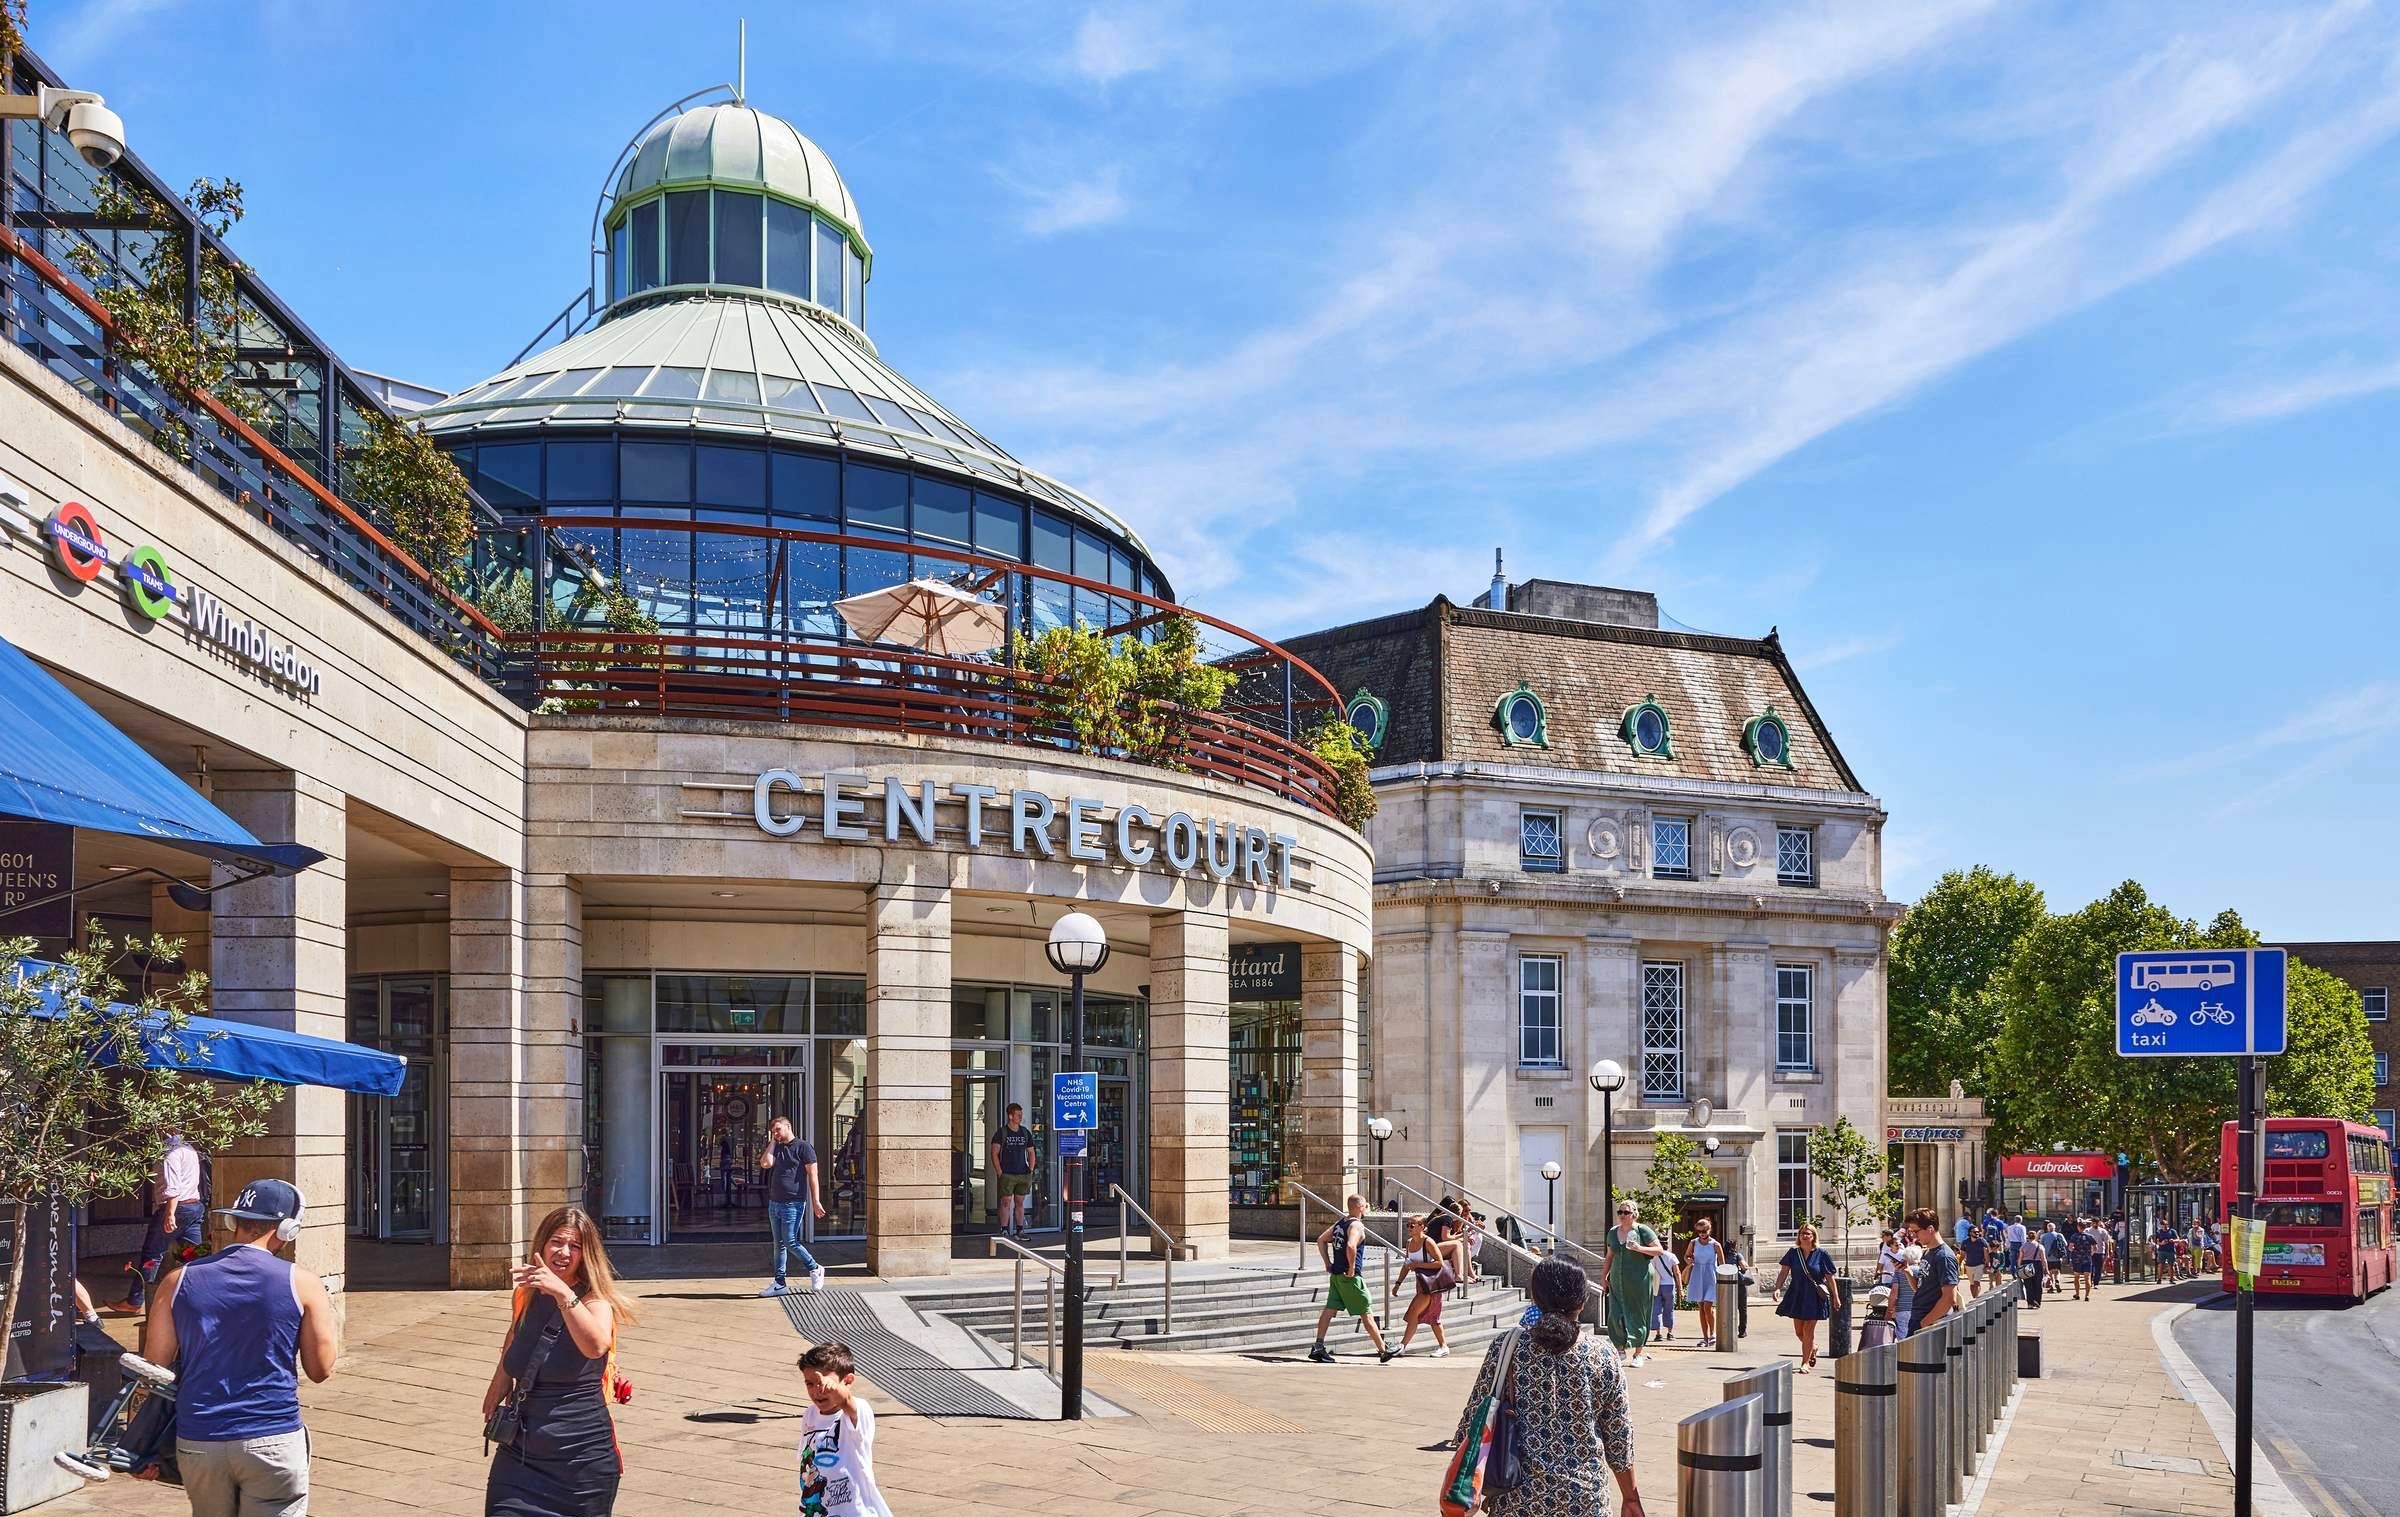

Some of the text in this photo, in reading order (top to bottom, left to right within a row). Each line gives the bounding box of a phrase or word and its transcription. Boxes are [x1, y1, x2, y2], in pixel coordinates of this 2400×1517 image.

[53, 522, 107, 560] UNDERGROUND
[142, 572, 164, 592] TRAMS
[188, 586, 320, 695] Wimbledon
[754, 768, 1299, 890] CENTRECOURT
[0, 853, 33, 869] 601
[0, 872, 57, 889] EEN'S
[1229, 953, 1285, 976] ttard
[1229, 978, 1273, 988] SEA 1886
[2131, 1032, 2166, 1046] taxi
[1903, 1127, 1965, 1140] express
[2027, 1161, 2084, 1173] Ladbrokes
[50, 1180, 63, 1333] owersmith
[10, 1329, 32, 1338] ACCEPTED
